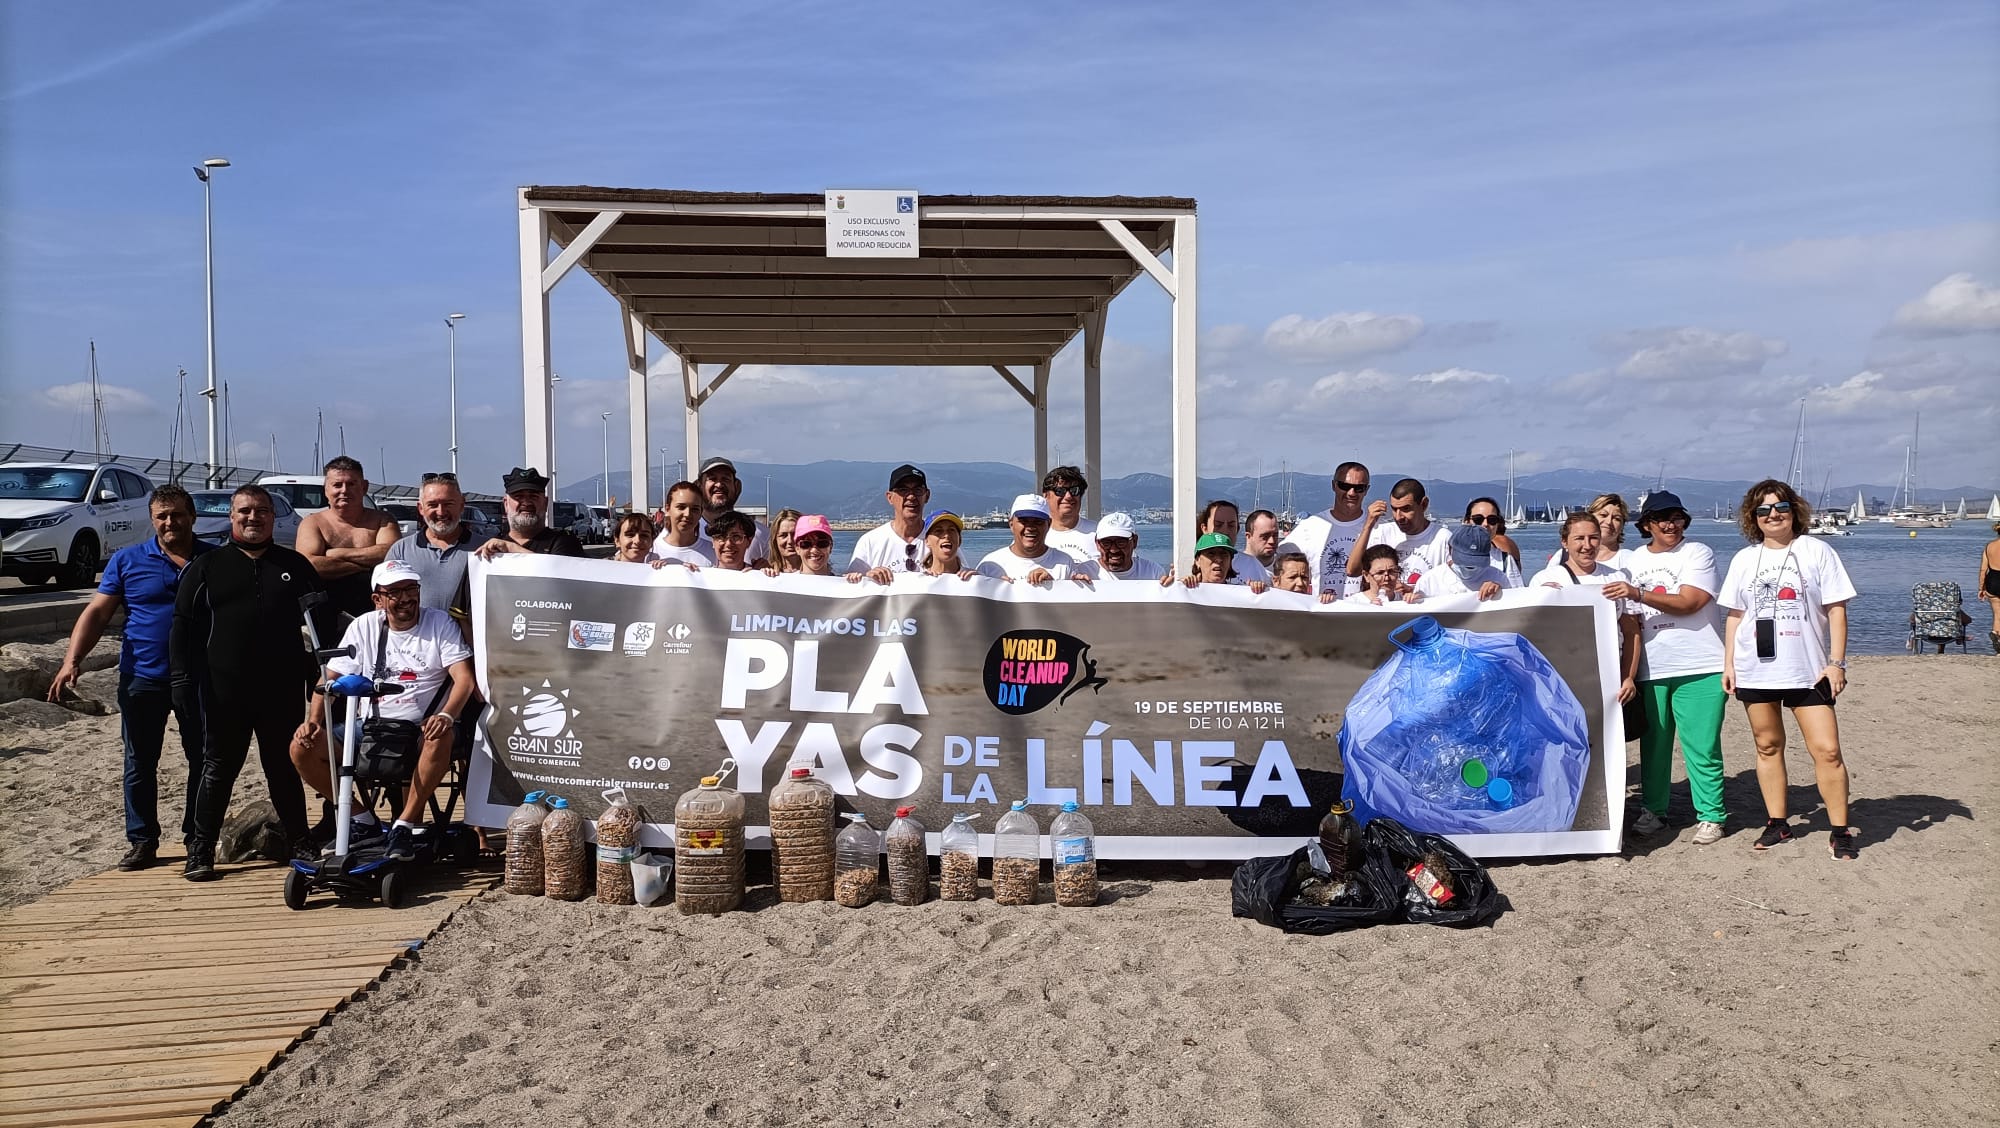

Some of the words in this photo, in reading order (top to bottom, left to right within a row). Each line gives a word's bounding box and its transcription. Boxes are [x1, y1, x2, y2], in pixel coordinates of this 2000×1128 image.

[842, 229, 852, 237] DE
[853, 229, 889, 237] PERSONAS
[863, 218, 901, 226] EXCLUSIVO
[837, 241, 876, 249] MOVILIDAD
[876, 241, 912, 250] REDUCIDA
[514, 599, 573, 611] COLABORAN
[730, 614, 867, 637] LIMPIAMOS
[872, 617, 919, 638] LAS
[663, 641, 693, 649] Carrefour
[1002, 637, 1057, 661] WORLD
[719, 637, 930, 716] PLA
[1000, 661, 1070, 685] CLEANUP
[997, 683, 1028, 708] DAY
[1134, 700, 1152, 714] 19
[1156, 700, 1179, 714] DE
[1182, 700, 1285, 715] SEPTIEMBRE
[1188, 716, 1212, 730] DE
[1215, 716, 1233, 730] 10
[1237, 716, 1250, 730] A
[1253, 716, 1270, 730] 12
[1273, 716, 1286, 730] H
[507, 735, 549, 754] GRAN
[553, 738, 584, 756] SUR
[942, 735, 1000, 768] DE
[510, 754, 536, 765] CENTRO
[537, 757, 582, 768] COMERCIAL
[713, 718, 924, 800] YAS
[1026, 719, 1312, 808] LÍNEA
[511, 769, 670, 791] www.centrocomercialgransur.es
[941, 772, 999, 805] LA
